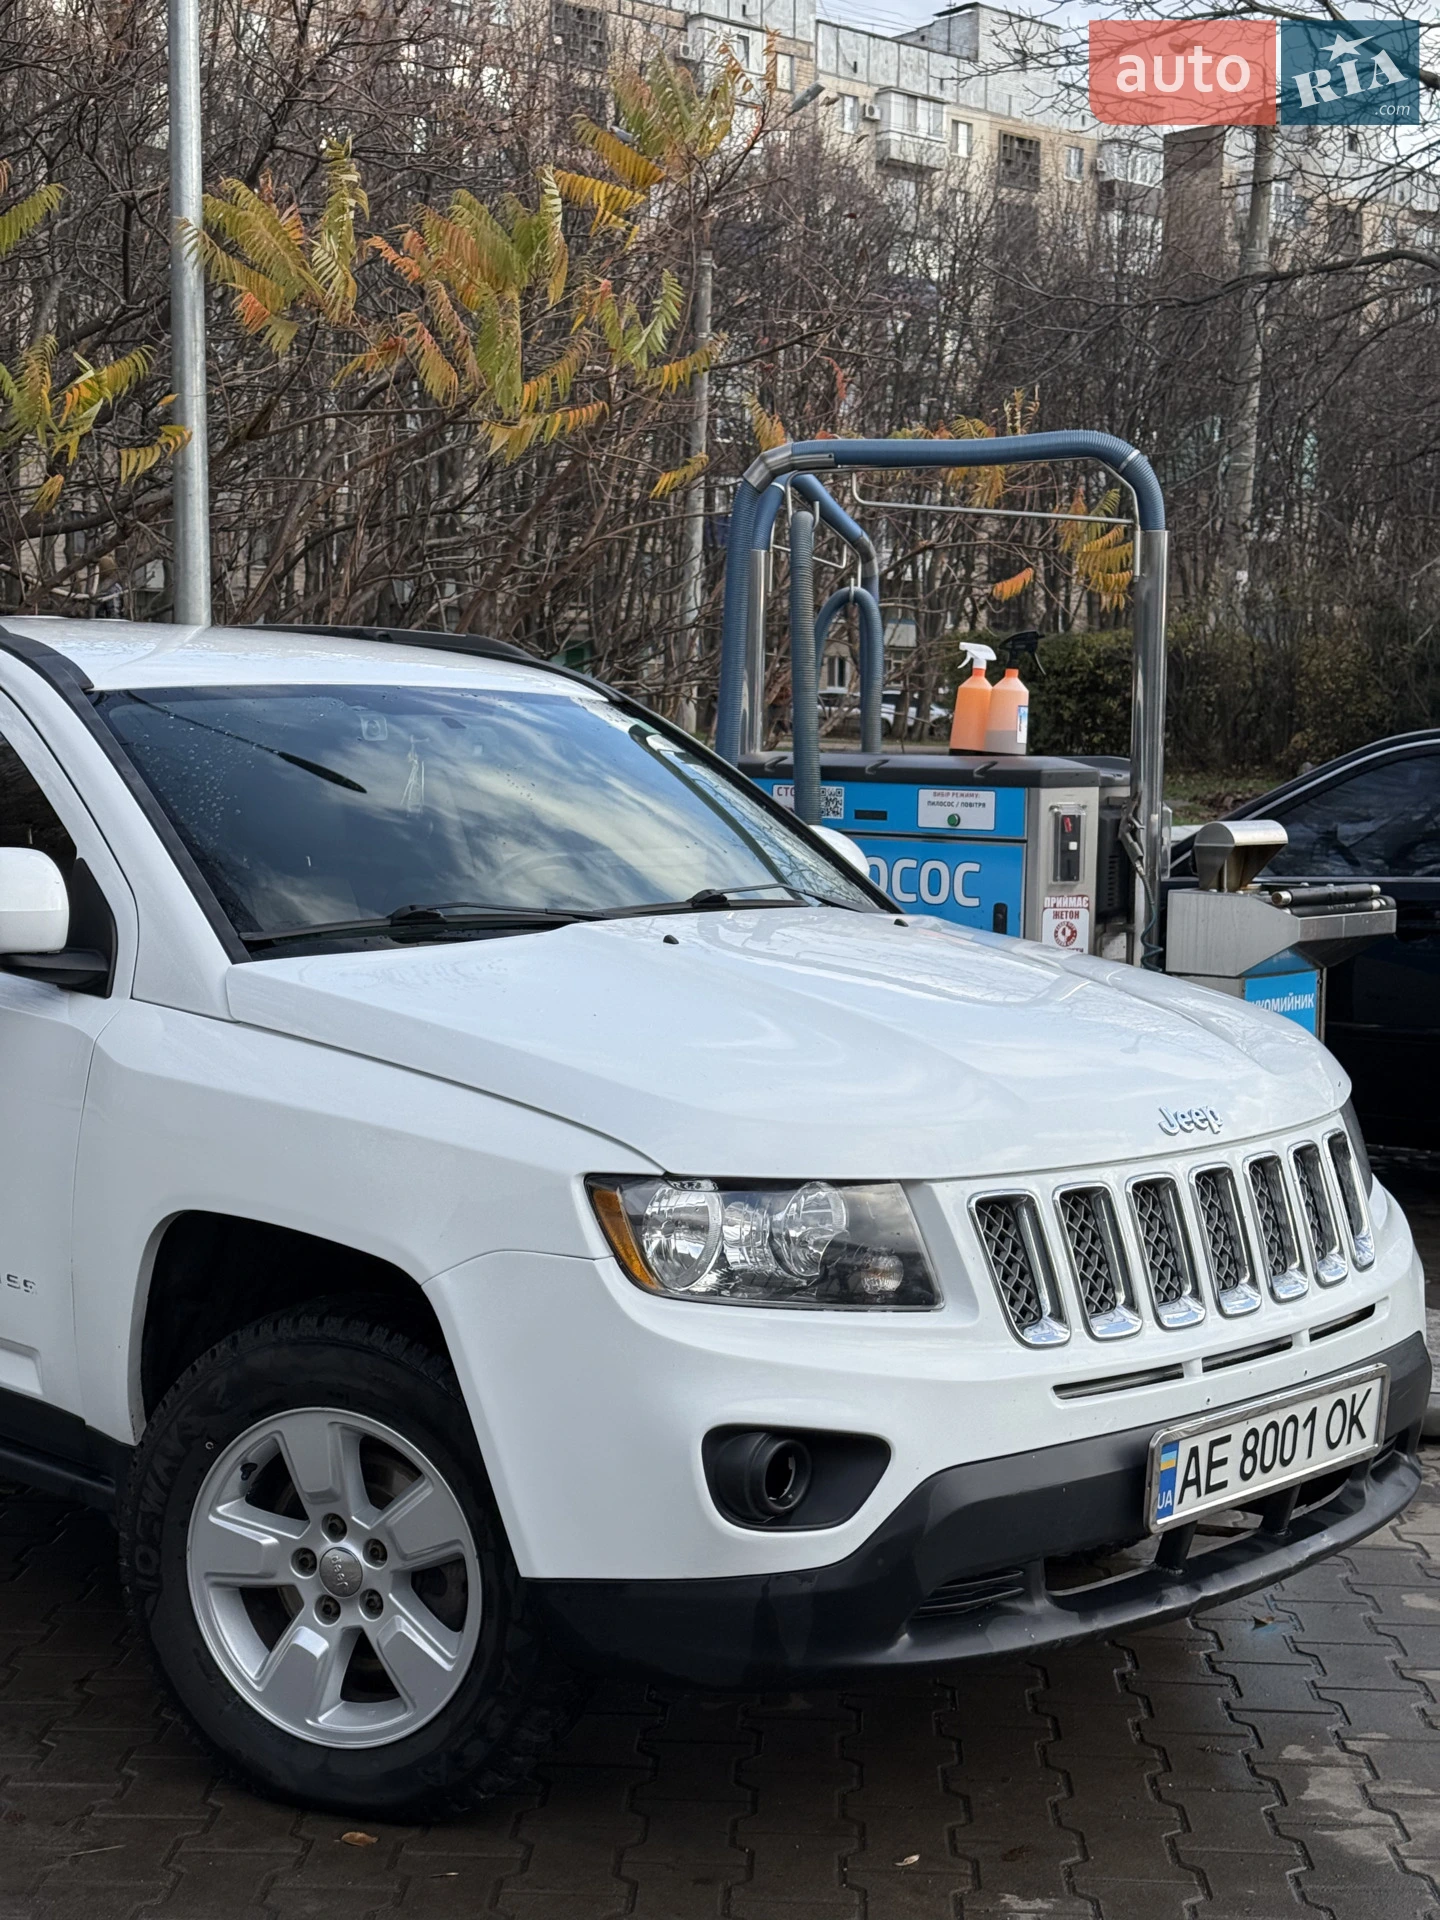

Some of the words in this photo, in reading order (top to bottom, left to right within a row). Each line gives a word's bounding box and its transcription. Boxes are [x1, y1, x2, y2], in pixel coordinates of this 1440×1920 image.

[927, 800, 954, 808] ПИЛОСОС
[960, 801, 986, 809] ПОВІТРЯ
[1044, 895, 1089, 908] ПРИЙМАЄ
[1053, 910, 1080, 920] ЖЕТОН
[1158, 1105, 1224, 1137] Jeep
[1177, 1434, 1232, 1505] AE
[1239, 1406, 1318, 1482] 8001
[1325, 1387, 1372, 1450] OK
[1156, 1489, 1173, 1510] UA
